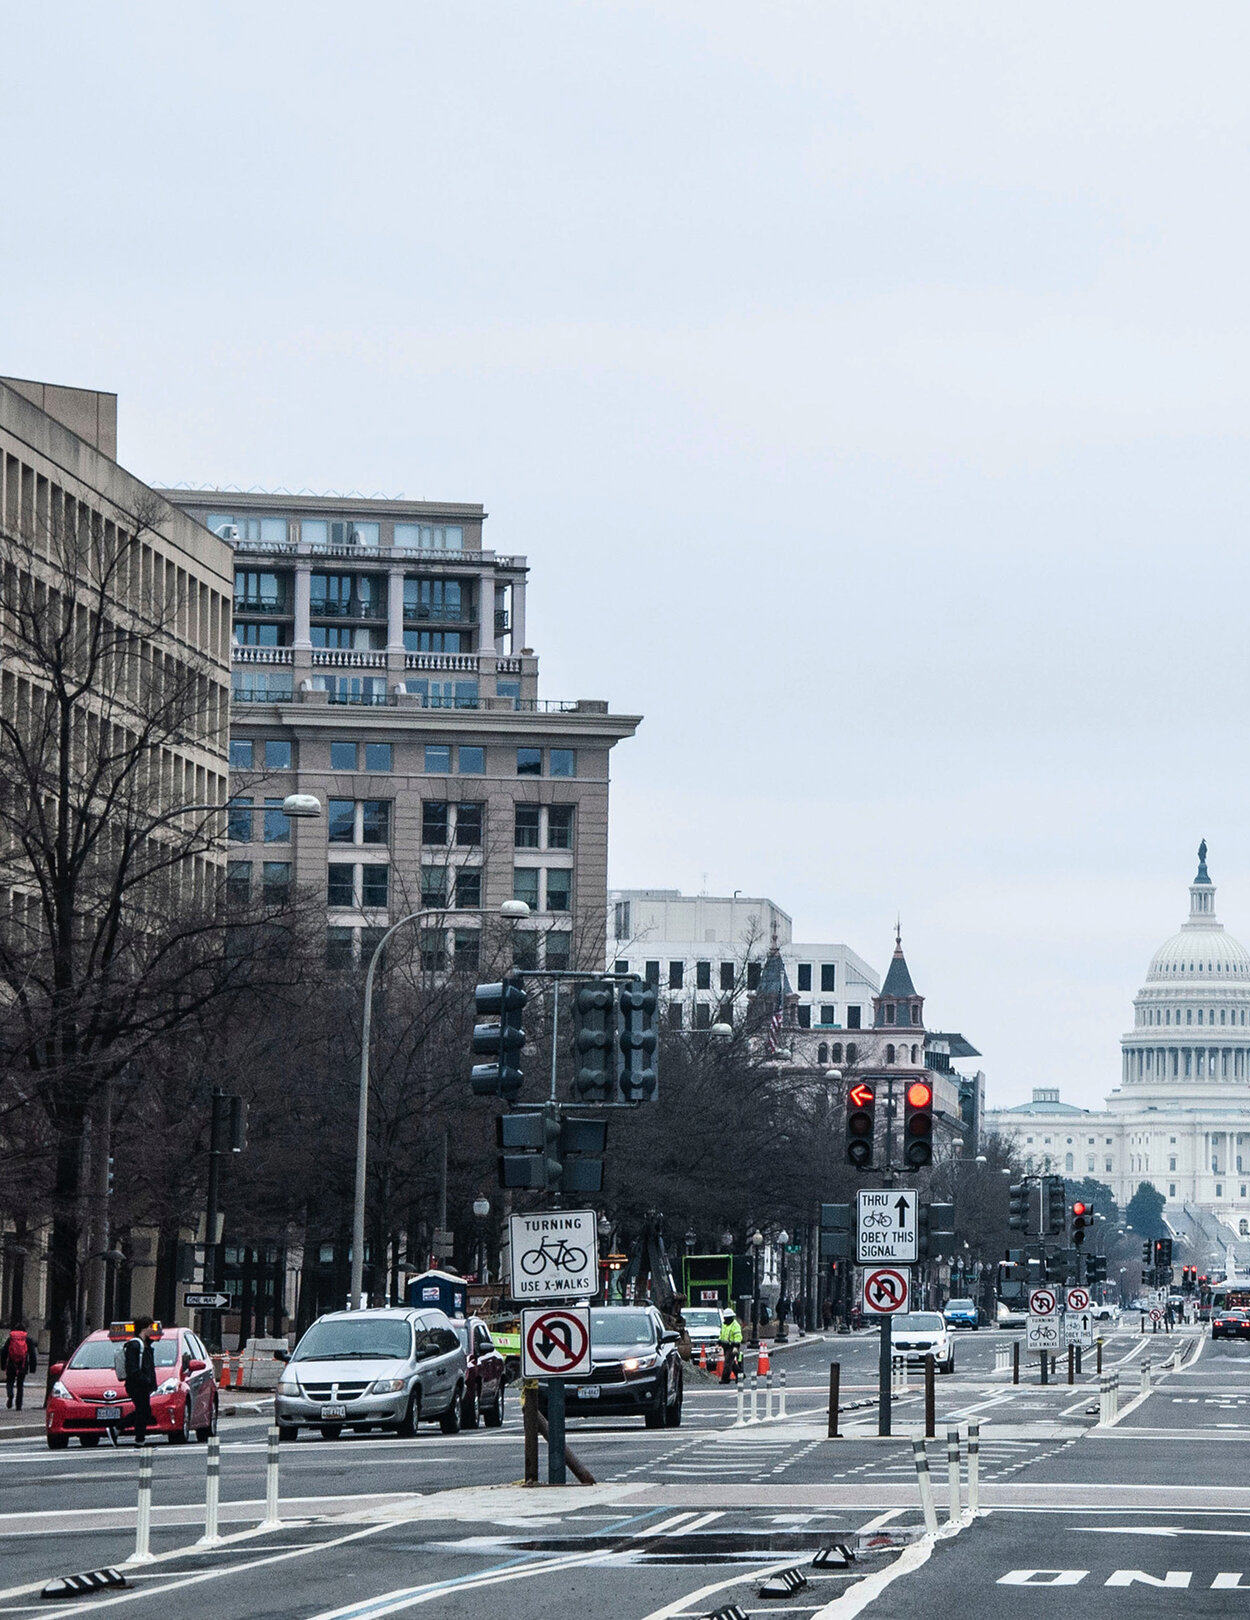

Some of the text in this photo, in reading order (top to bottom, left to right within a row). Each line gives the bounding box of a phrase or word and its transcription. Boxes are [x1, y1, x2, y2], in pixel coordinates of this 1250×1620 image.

[862, 1195, 888, 1206] THRU
[525, 1219, 581, 1231] TURNING
[861, 1231, 914, 1243] OBEY THIS
[861, 1245, 897, 1257] SIGNAL
[521, 1278, 589, 1292] USE X-WALKS
